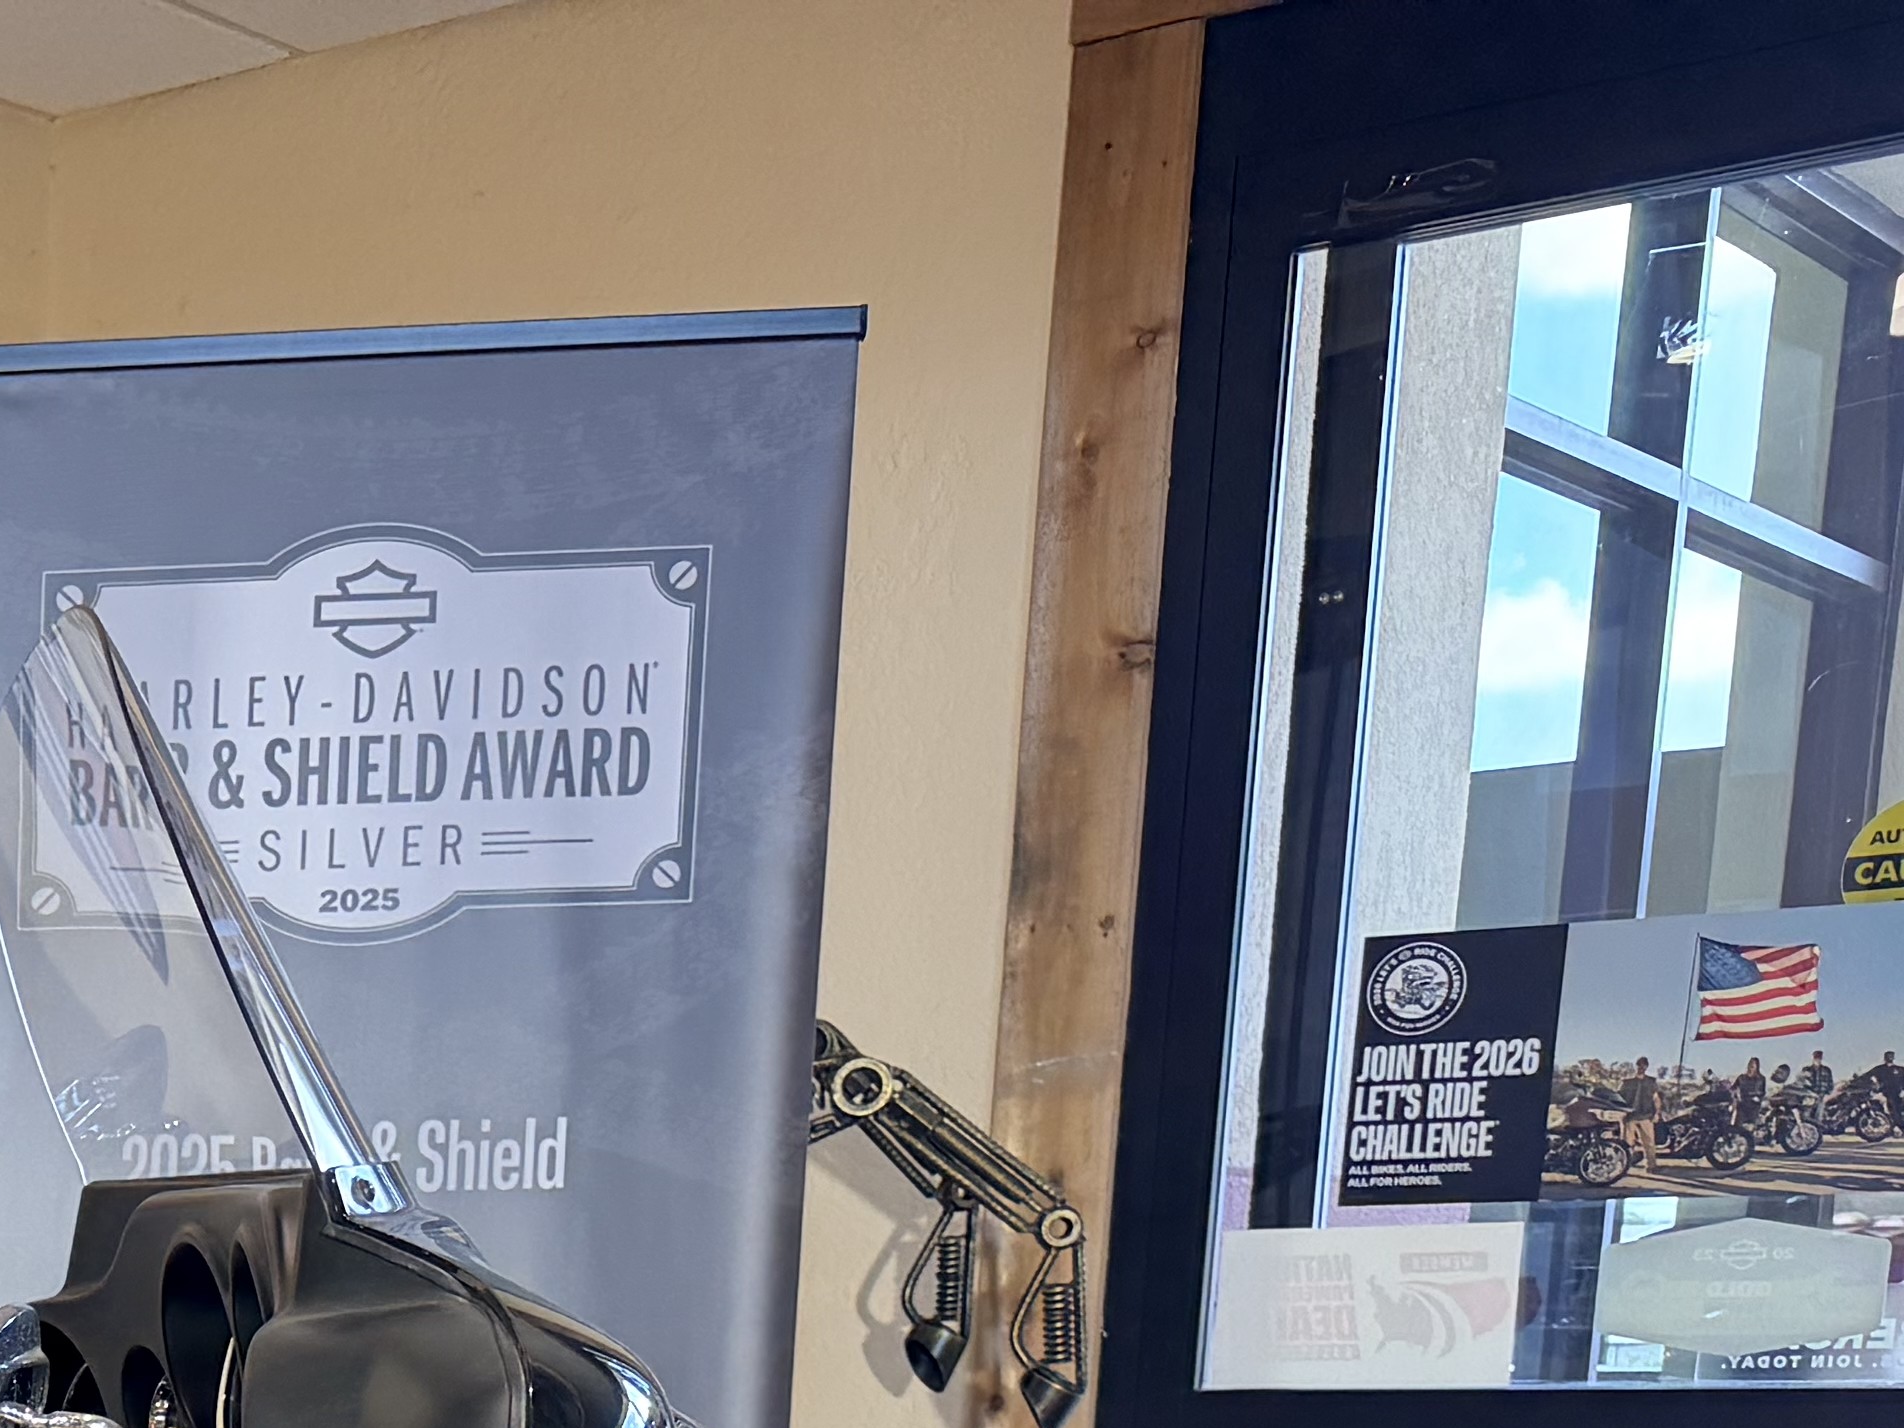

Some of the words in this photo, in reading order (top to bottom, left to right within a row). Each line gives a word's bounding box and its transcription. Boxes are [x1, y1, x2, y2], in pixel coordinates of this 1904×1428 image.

[208, 738, 244, 809] &
[262, 732, 449, 808] SHIELD
[460, 725, 651, 802] AWARD
[257, 824, 464, 873] SILVER
[1869, 828, 1904, 846] AU
[318, 887, 402, 914] 2025
[1356, 1045, 1417, 1083] JOIN
[1419, 1041, 1470, 1080] THE
[1472, 1037, 1542, 1077] 2026
[1353, 1083, 1423, 1122] LET'S
[1426, 1081, 1488, 1119] RIDE
[415, 1116, 569, 1193] Shield
[1349, 1120, 1496, 1162] CHALLENGE
[1347, 1177, 1368, 1188] ALL
[1370, 1176, 1393, 1187] FOR
[1348, 1165, 1369, 1175] ALL
[1406, 1164, 1428, 1174] ALL
